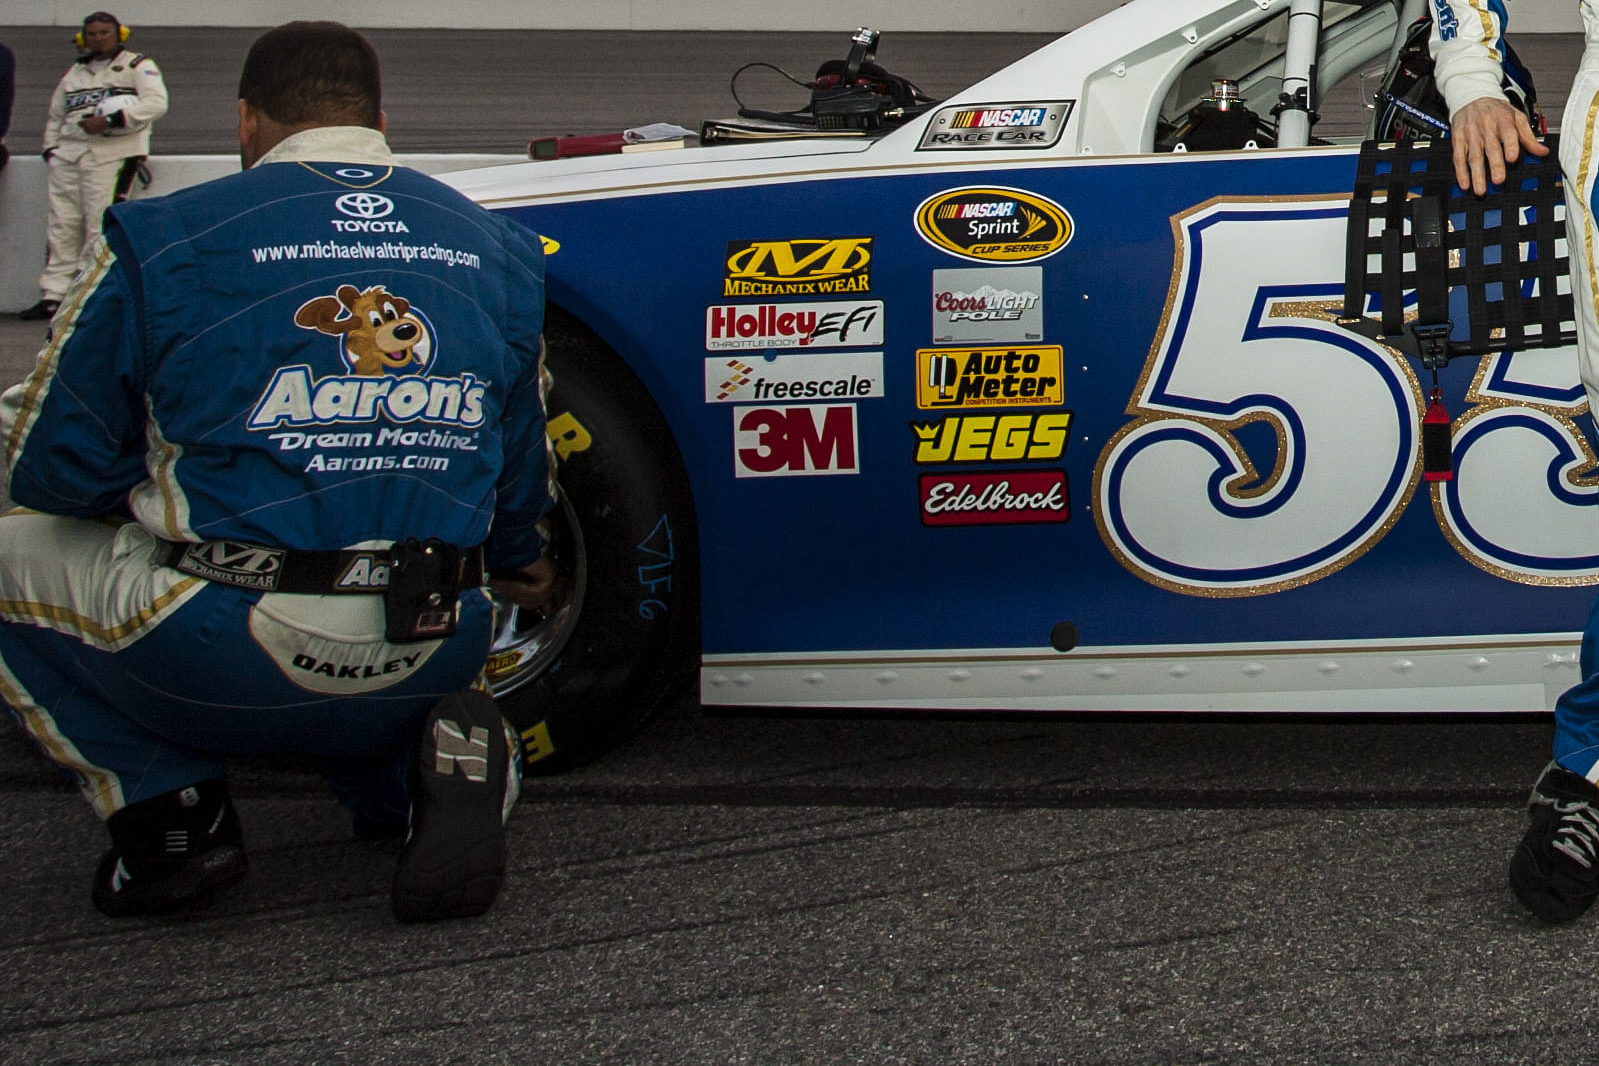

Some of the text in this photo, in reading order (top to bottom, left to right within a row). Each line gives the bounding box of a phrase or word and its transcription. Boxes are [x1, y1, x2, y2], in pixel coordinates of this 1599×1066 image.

[978, 110, 1041, 126] NASCAR
[930, 132, 1046, 142] RACE CAR
[961, 202, 1014, 218] NASCAR
[331, 220, 409, 233] TOYOTA
[968, 218, 1020, 239] Sprint
[252, 240, 480, 269] www.michaelwaltripracing.com
[972, 243, 1050, 254] CUP SERIES
[724, 274, 870, 296] MECHANIX WEAR
[935, 292, 1040, 312] Coors LIGHT
[711, 305, 879, 345] Holley EFI
[950, 310, 1023, 321] POLE
[768, 339, 797, 347] BODY
[963, 352, 1041, 375] Auto
[250, 366, 487, 426] Aaron's
[753, 375, 872, 399] freescale
[955, 375, 1056, 399] Meter
[269, 428, 477, 450] Dream Machine
[738, 406, 855, 471] 3M
[914, 414, 1069, 462] JEGS
[304, 454, 449, 472] Aarons.com
[924, 482, 1064, 513] Edelbrock
[235, 573, 275, 587] WEAR
[292, 652, 421, 679] OAKLEY
